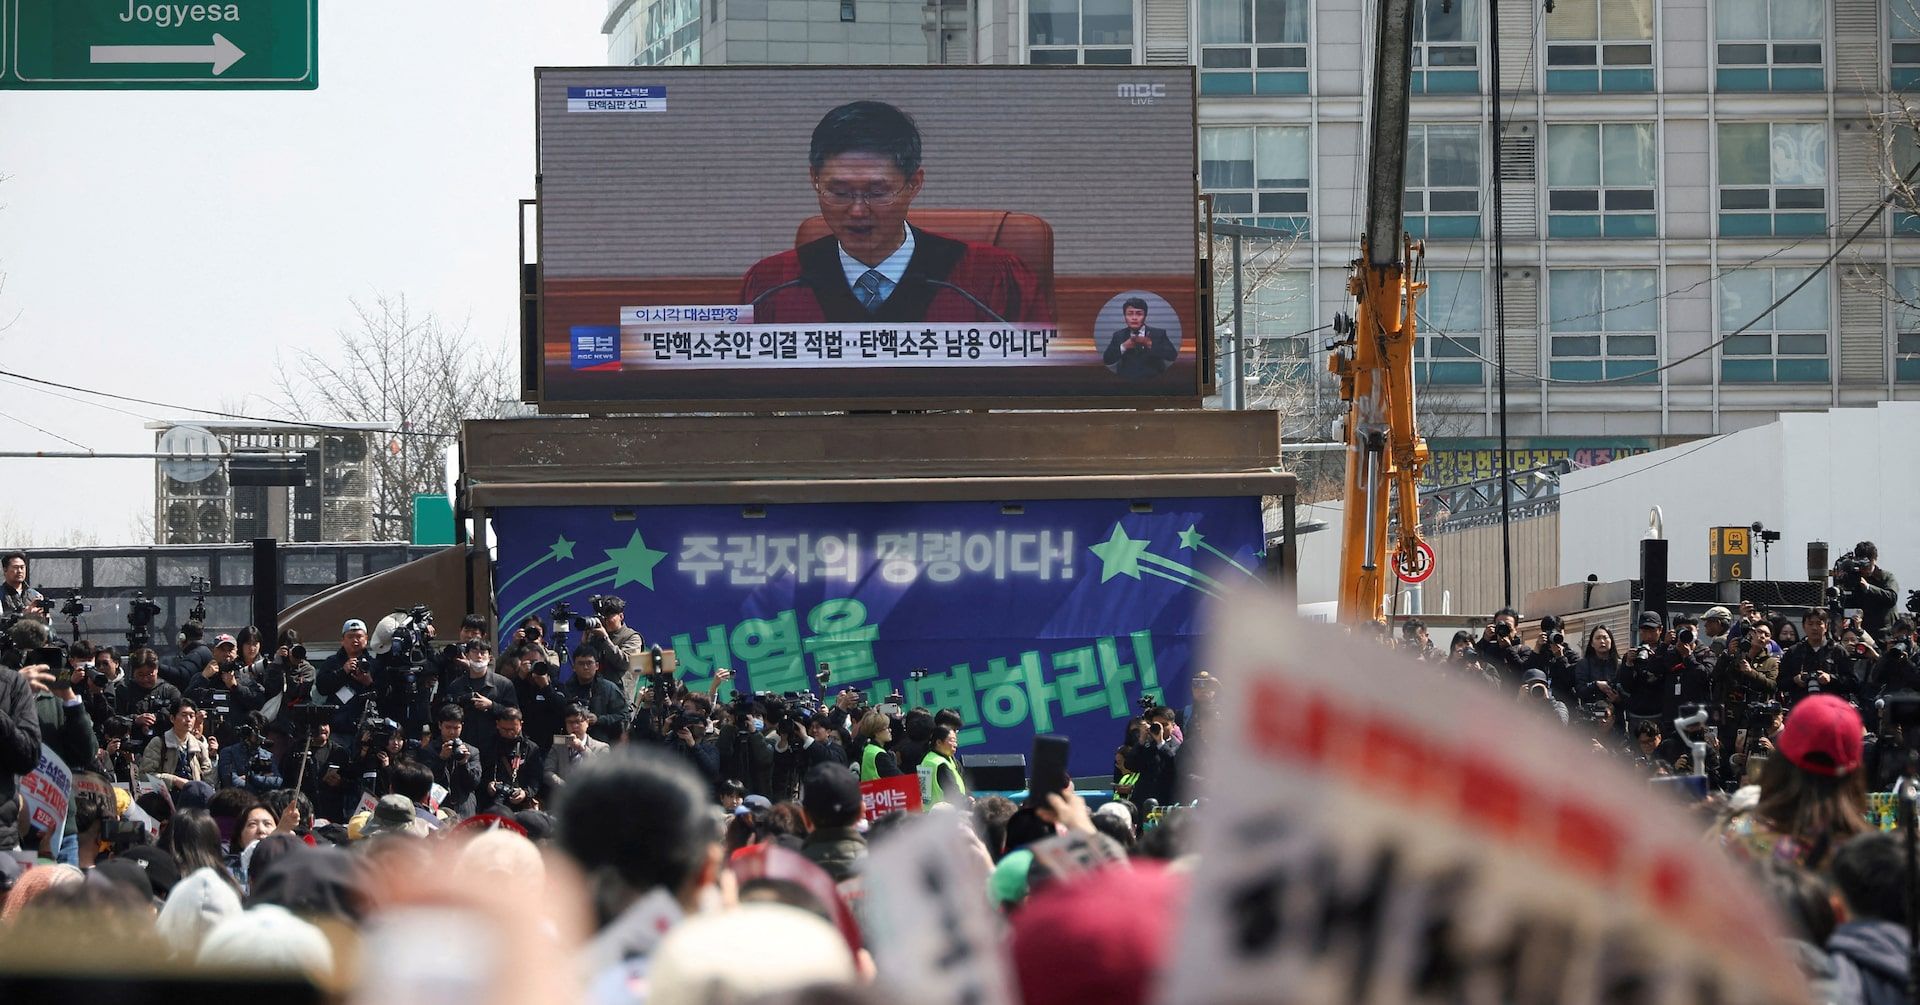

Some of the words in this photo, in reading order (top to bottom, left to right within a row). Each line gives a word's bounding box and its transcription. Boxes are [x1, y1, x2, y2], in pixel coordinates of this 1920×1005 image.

[119, 0, 240, 27] Jogyesa
[614, 88, 649, 97] 뉴스특보
[587, 100, 625, 110] 탄핵심판
[628, 100, 648, 110] 선고
[636, 309, 649, 322] 이
[653, 308, 681, 322] 시각
[684, 307, 739, 322] 대심판정
[577, 336, 614, 352] 특보
[759, 330, 798, 360] 의결
[944, 328, 984, 360] 남용
[677, 533, 858, 586] 주권자의
[876, 530, 1074, 584] 명령이다!
[1731, 562, 1742, 578] 6
[640, 598, 880, 704] 석열을
[824, 630, 1165, 747] 면하라!
